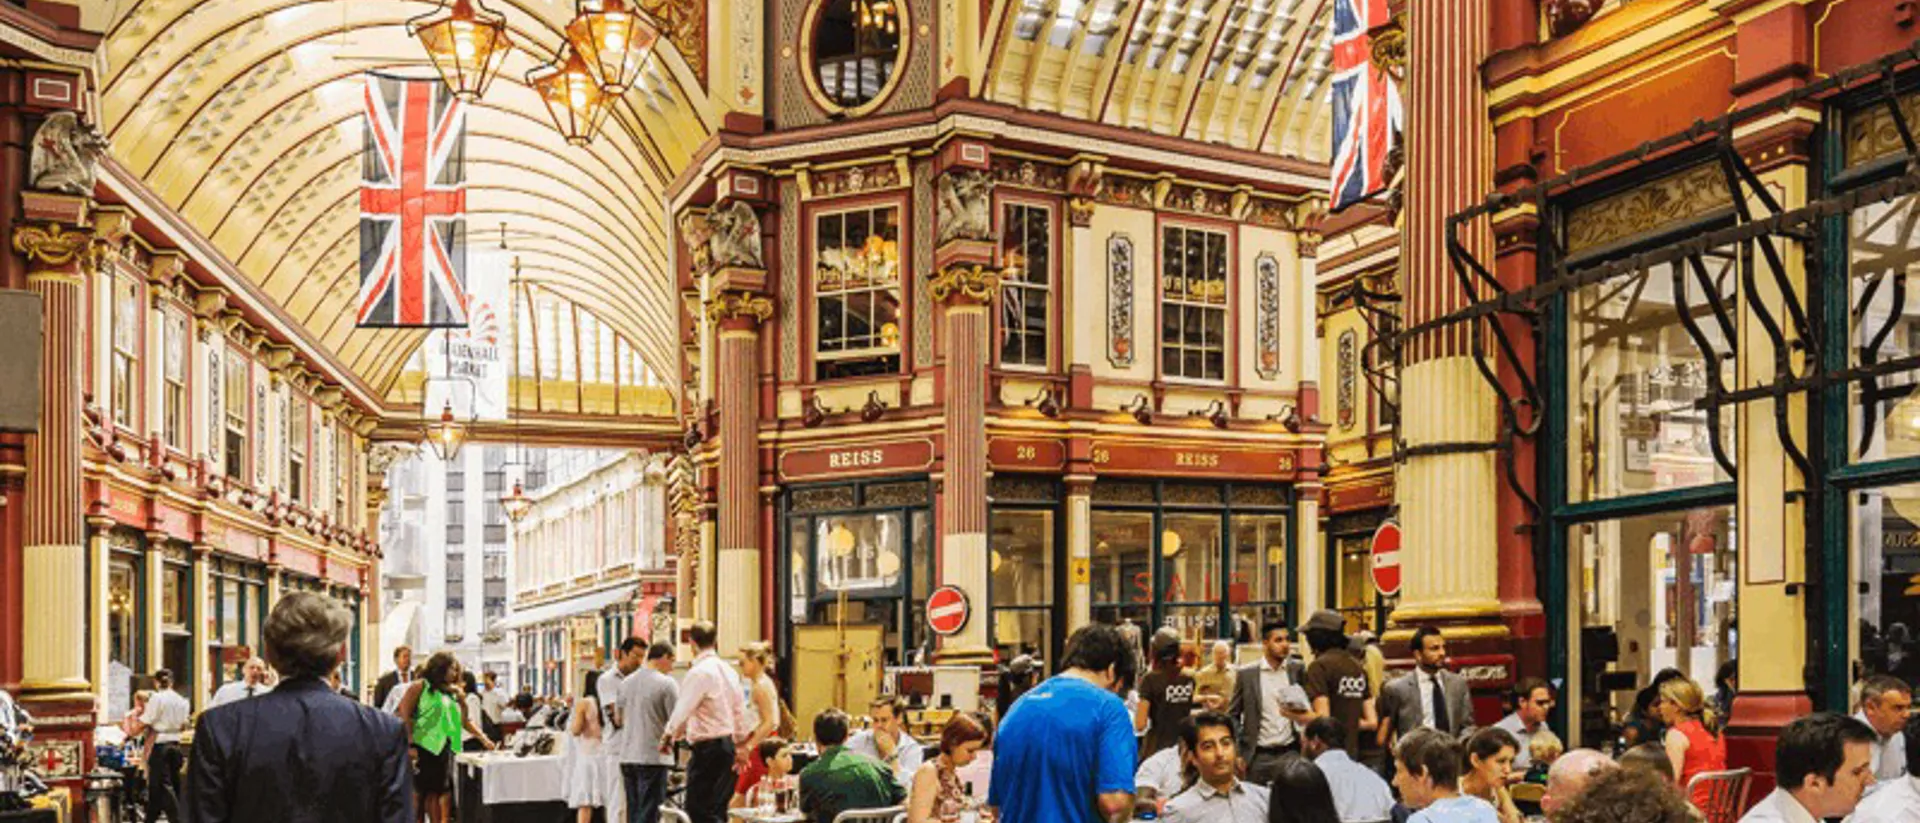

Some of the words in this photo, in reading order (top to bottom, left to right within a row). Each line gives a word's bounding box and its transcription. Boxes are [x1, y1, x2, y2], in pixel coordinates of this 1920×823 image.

[829, 448, 884, 468] REISS
[1017, 445, 1036, 460] 26
[1175, 452, 1219, 467] REISS
[1165, 682, 1194, 702] pod
[1338, 673, 1367, 694] pod
